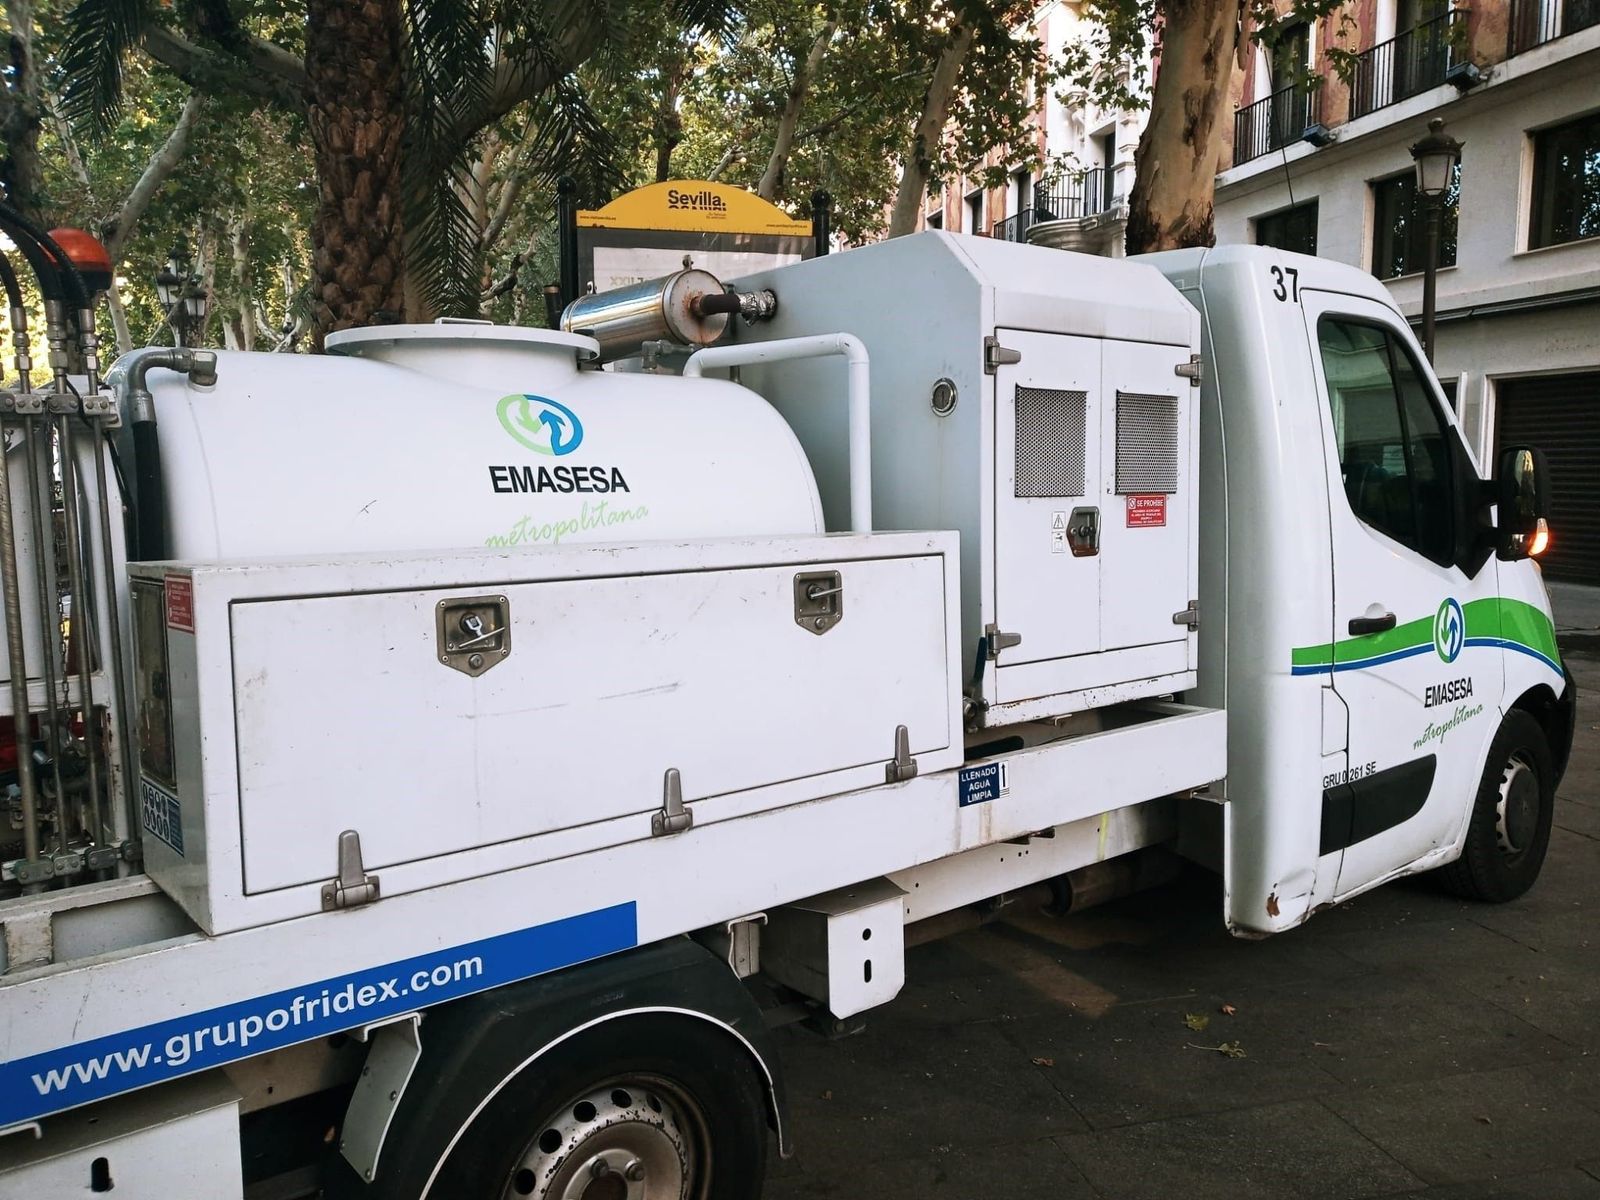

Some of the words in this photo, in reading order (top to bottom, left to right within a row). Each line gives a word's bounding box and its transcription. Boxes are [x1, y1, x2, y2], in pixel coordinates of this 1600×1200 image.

[668, 189, 727, 207] Sevilla.
[1270, 265, 1298, 303] 37
[488, 465, 630, 493] EMASESA
[485, 500, 649, 548] metropolitana
[1424, 677, 1473, 708] EMASESA
[1413, 703, 1483, 750] metropolitana
[961, 767, 996, 781] LLENADO
[968, 779, 990, 791] AGUA
[1322, 771, 1341, 788] GRU
[1365, 761, 1376, 776] SE
[967, 790, 992, 802] LIMPIA
[31, 955, 484, 1096] www.grupofridex.com
